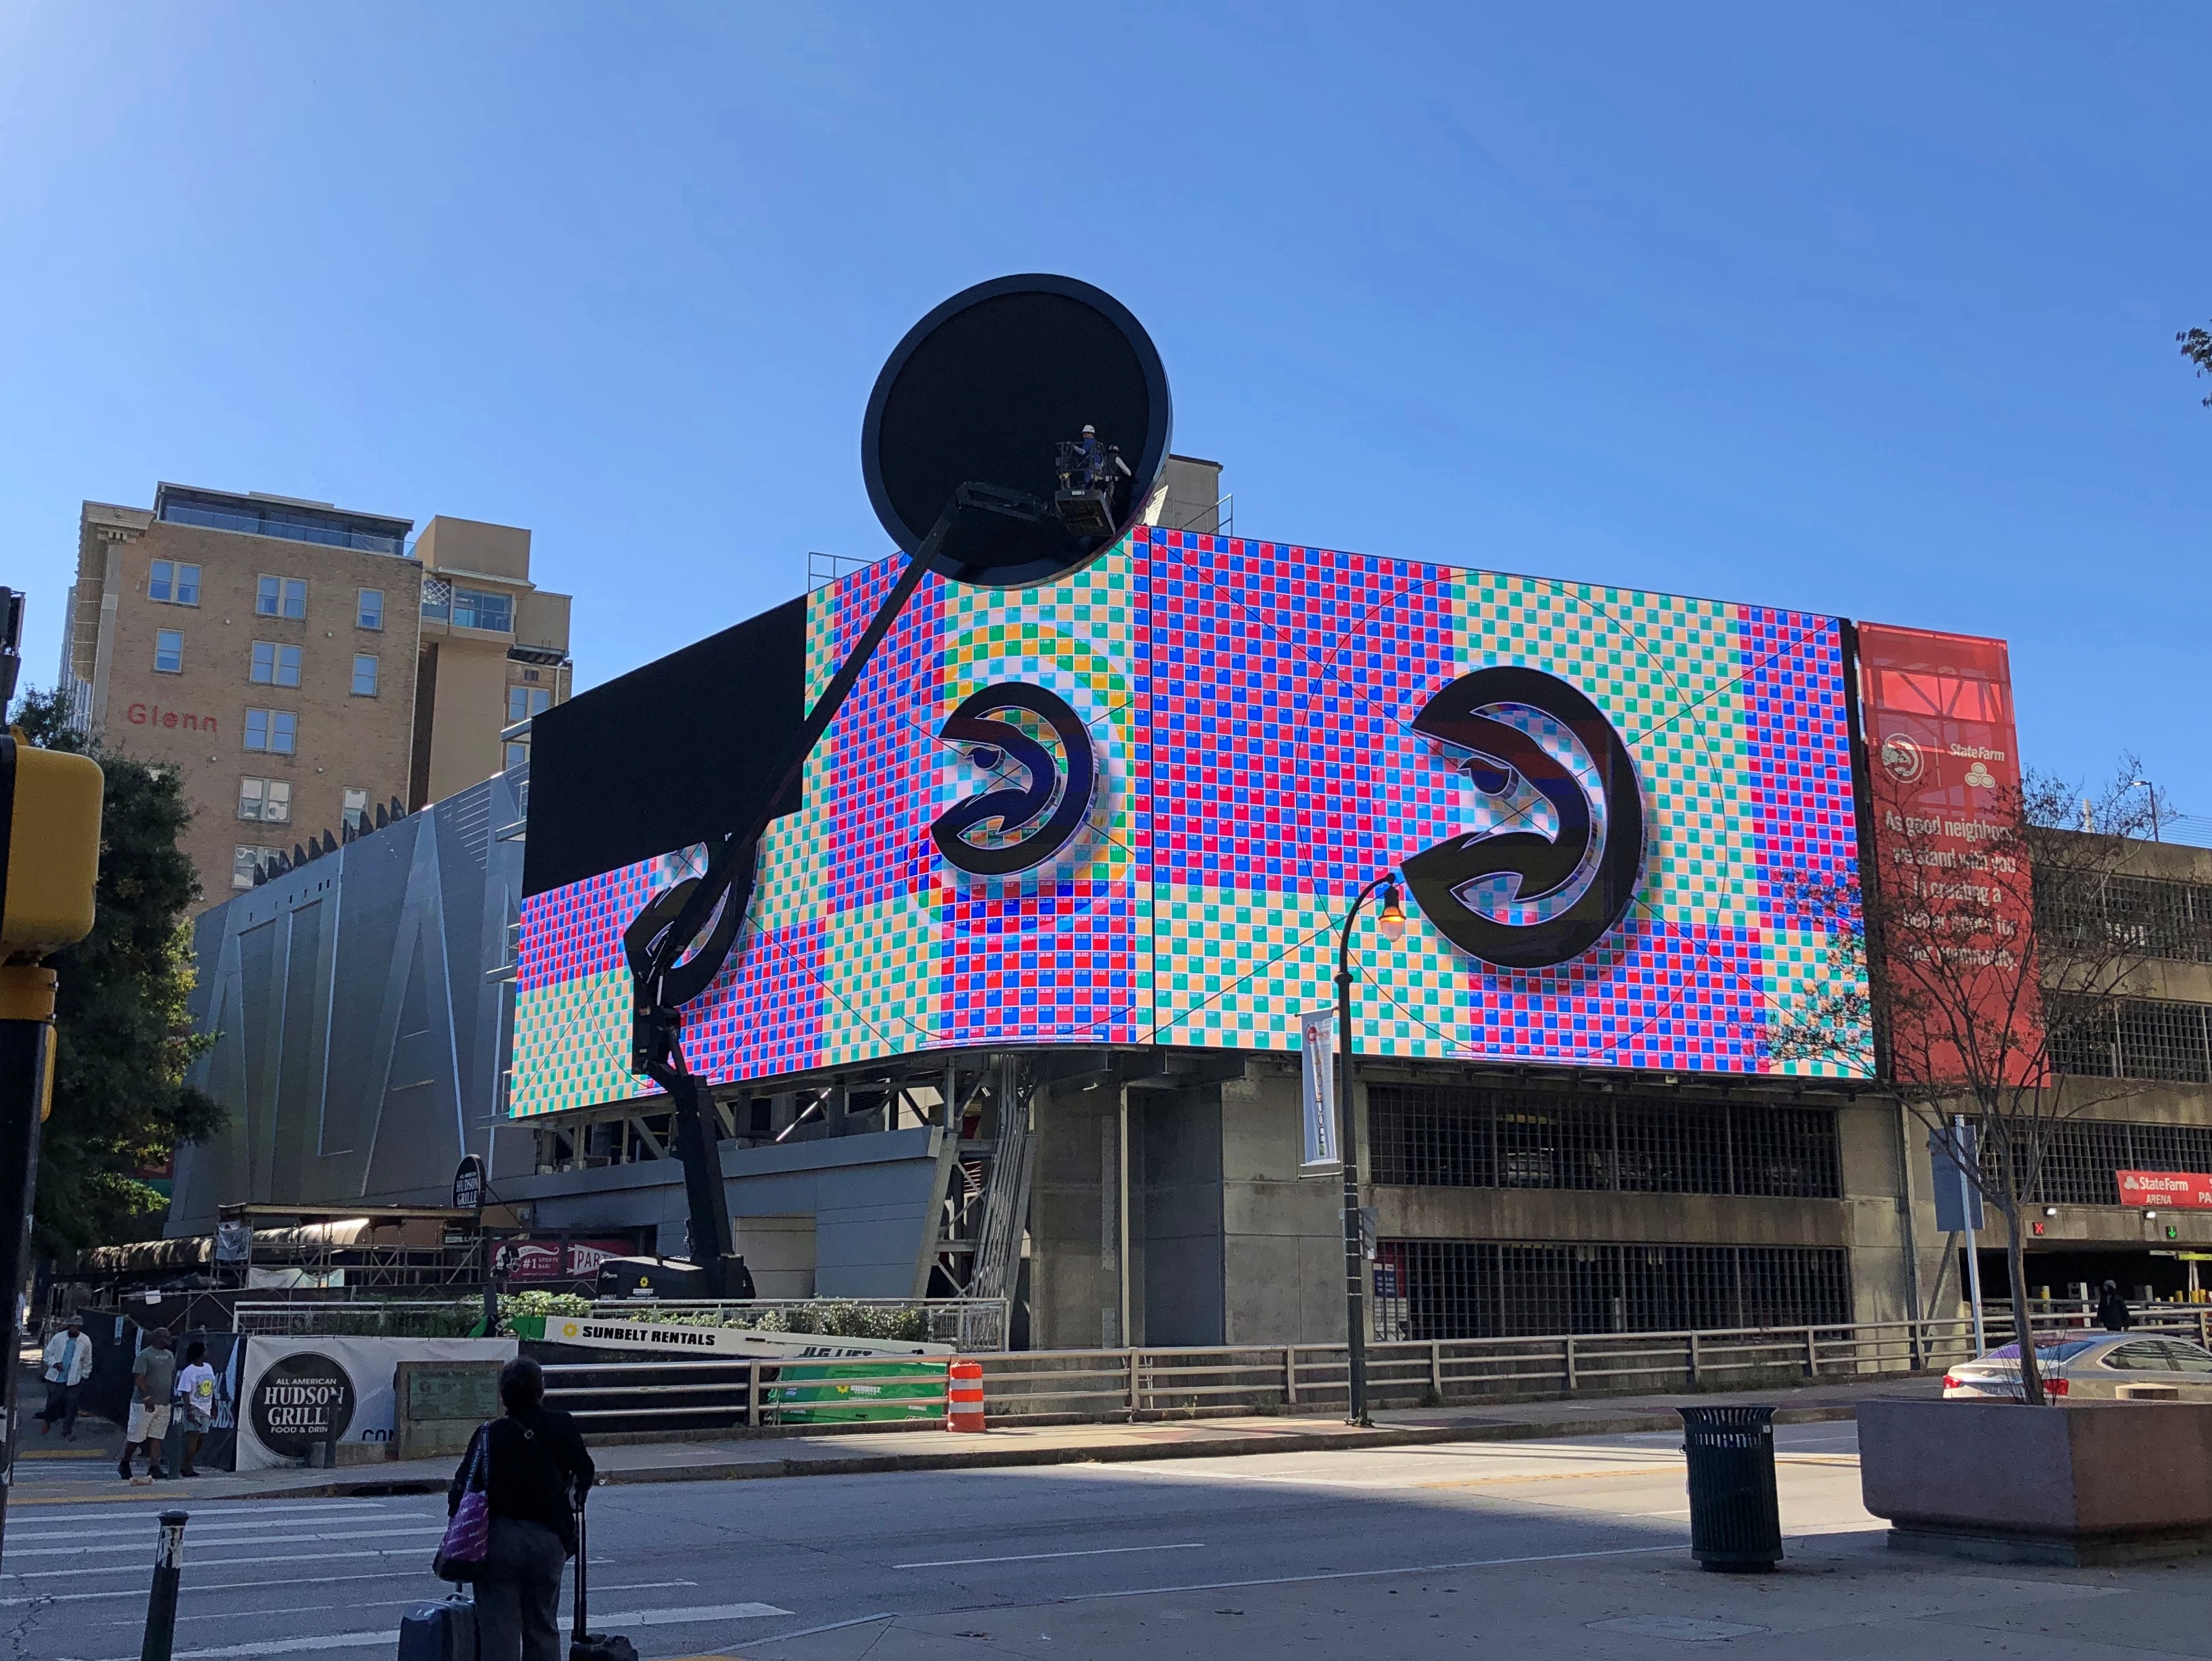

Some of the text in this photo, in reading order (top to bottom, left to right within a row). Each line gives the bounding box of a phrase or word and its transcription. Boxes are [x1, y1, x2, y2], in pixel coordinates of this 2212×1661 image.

[128, 703, 217, 733] Glenn
[1886, 810, 1902, 831] As
[1906, 815, 1942, 837] good
[1991, 856, 2016, 876] you
[1992, 887, 2001, 903] a
[456, 1176, 478, 1193] HUDSON
[457, 1190, 477, 1206] GRILLE
[2146, 1194, 2172, 1205] ARENA
[523, 1258, 537, 1269] #1
[582, 1325, 716, 1346] SUNBELT RENTALS
